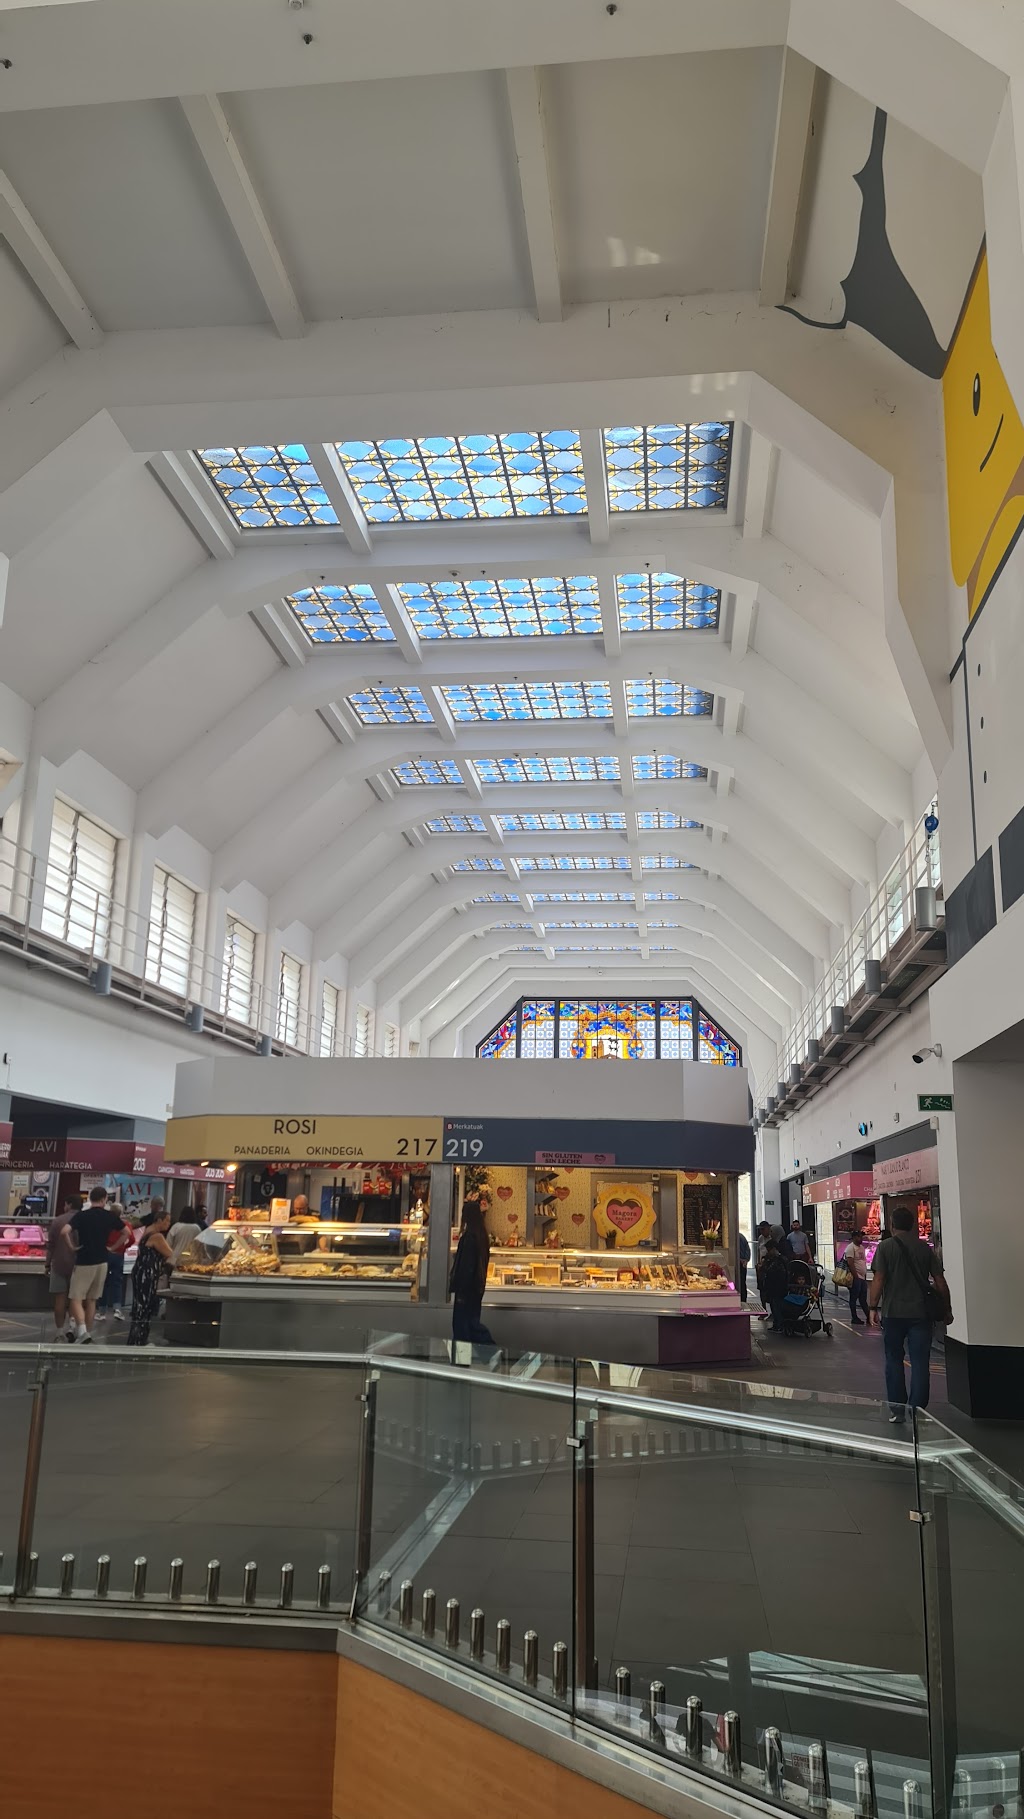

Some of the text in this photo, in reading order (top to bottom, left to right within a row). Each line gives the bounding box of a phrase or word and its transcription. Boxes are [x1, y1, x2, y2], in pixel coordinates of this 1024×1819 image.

[273, 1119, 316, 1135] ROSI
[29, 1140, 57, 1153] JAVI
[234, 1145, 364, 1156] PANADERIA OKINDEGIA
[396, 1138, 437, 1156] 217
[445, 1138, 484, 1157] 219
[49, 1160, 92, 1170] HARATEGIA
[132, 1157, 146, 1172] 203
[612, 1209, 637, 1217] Magora
